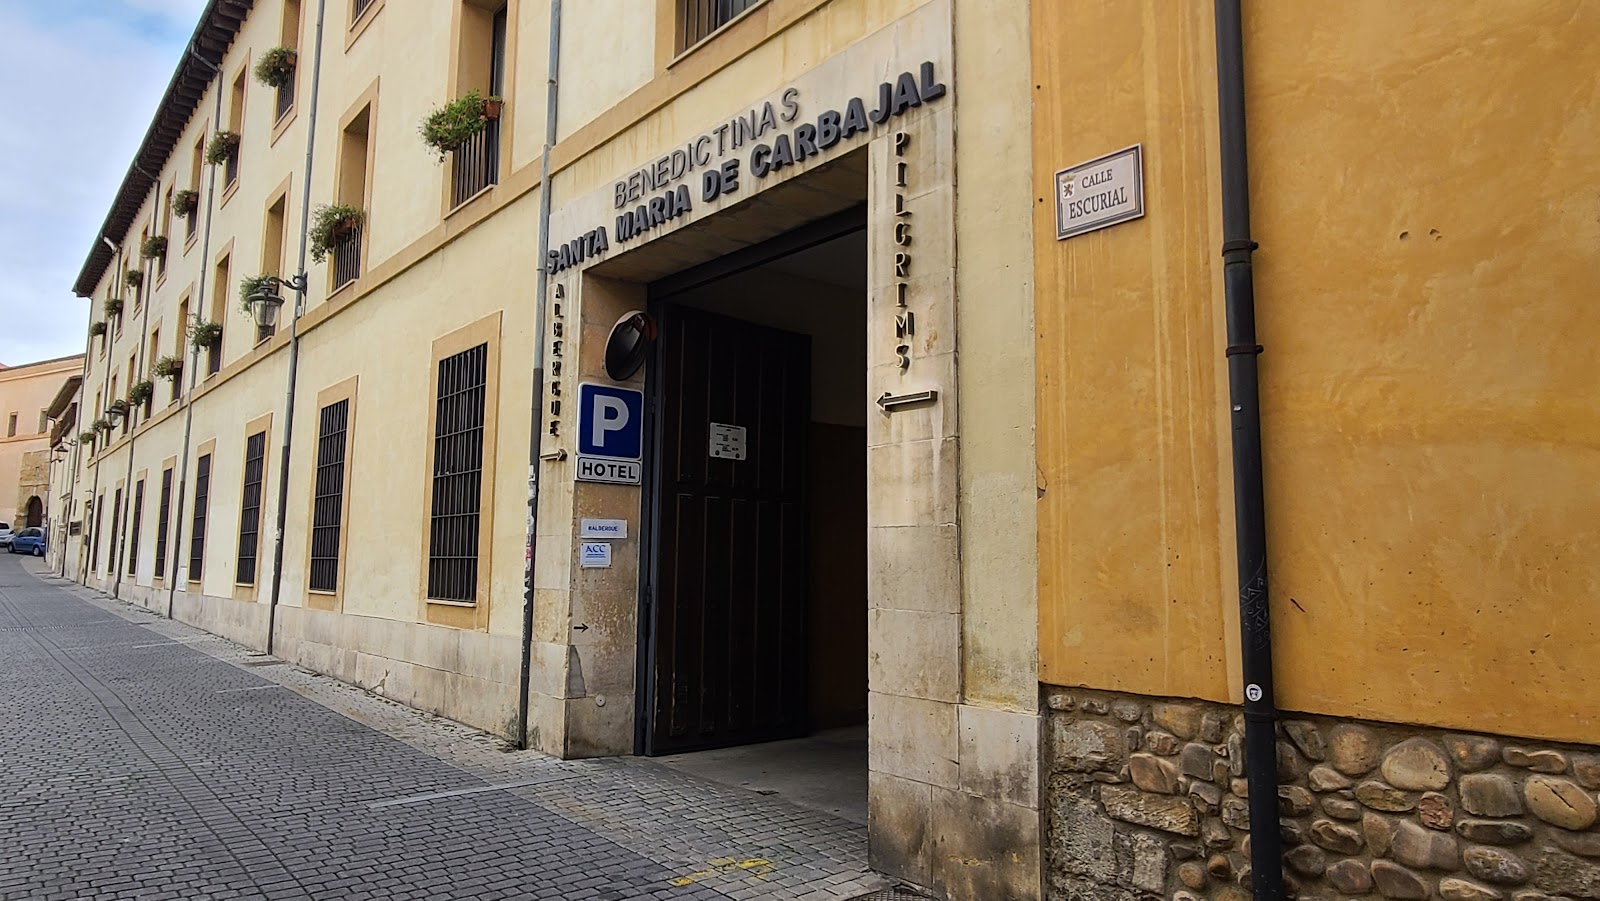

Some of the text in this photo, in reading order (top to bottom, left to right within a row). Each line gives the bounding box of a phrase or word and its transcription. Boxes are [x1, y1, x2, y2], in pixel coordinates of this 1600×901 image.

[546, 61, 946, 275] SANTA MARIA DE CARBAJAL
[614, 87, 800, 209] BENEDICTINAS
[1068, 186, 1128, 220] ESCURIAL
[1081, 168, 1113, 189] CALLE
[894, 131, 914, 371] PILGRIMS
[549, 283, 565, 437] ALBERGUE
[592, 393, 630, 447] P
[582, 461, 636, 480] HOTEL
[585, 544, 606, 553] ACC
